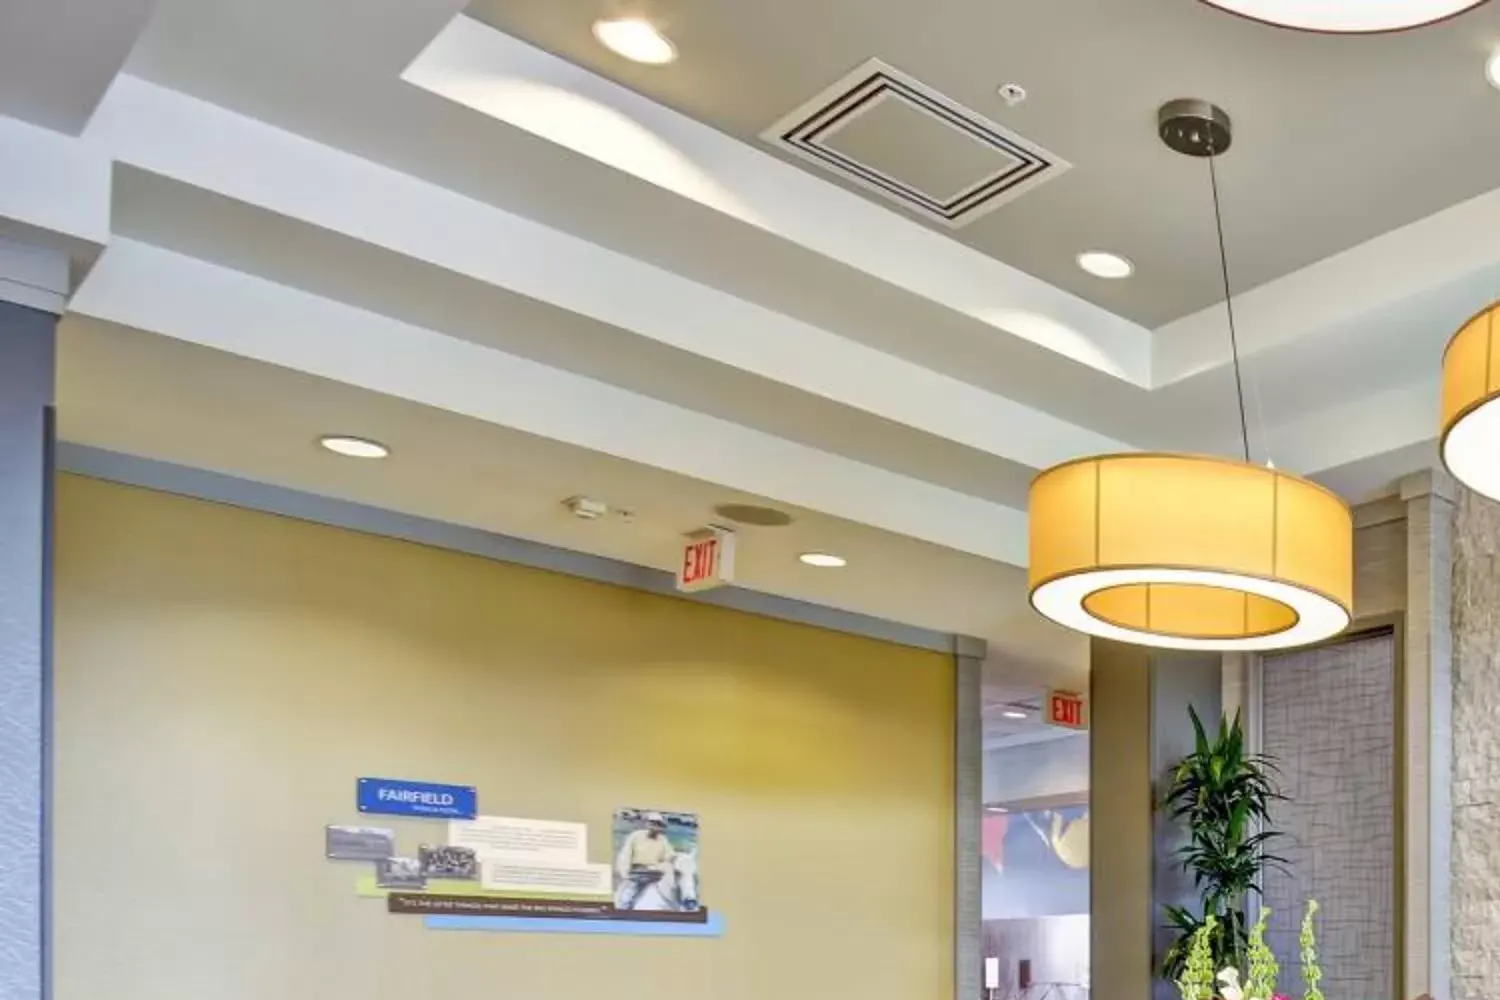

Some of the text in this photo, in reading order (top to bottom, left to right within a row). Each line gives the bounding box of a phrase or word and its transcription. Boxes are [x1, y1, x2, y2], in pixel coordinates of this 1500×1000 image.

[683, 540, 717, 584] EXIT
[1052, 694, 1082, 724] EXIT
[378, 789, 454, 806] FAIRFIELD
